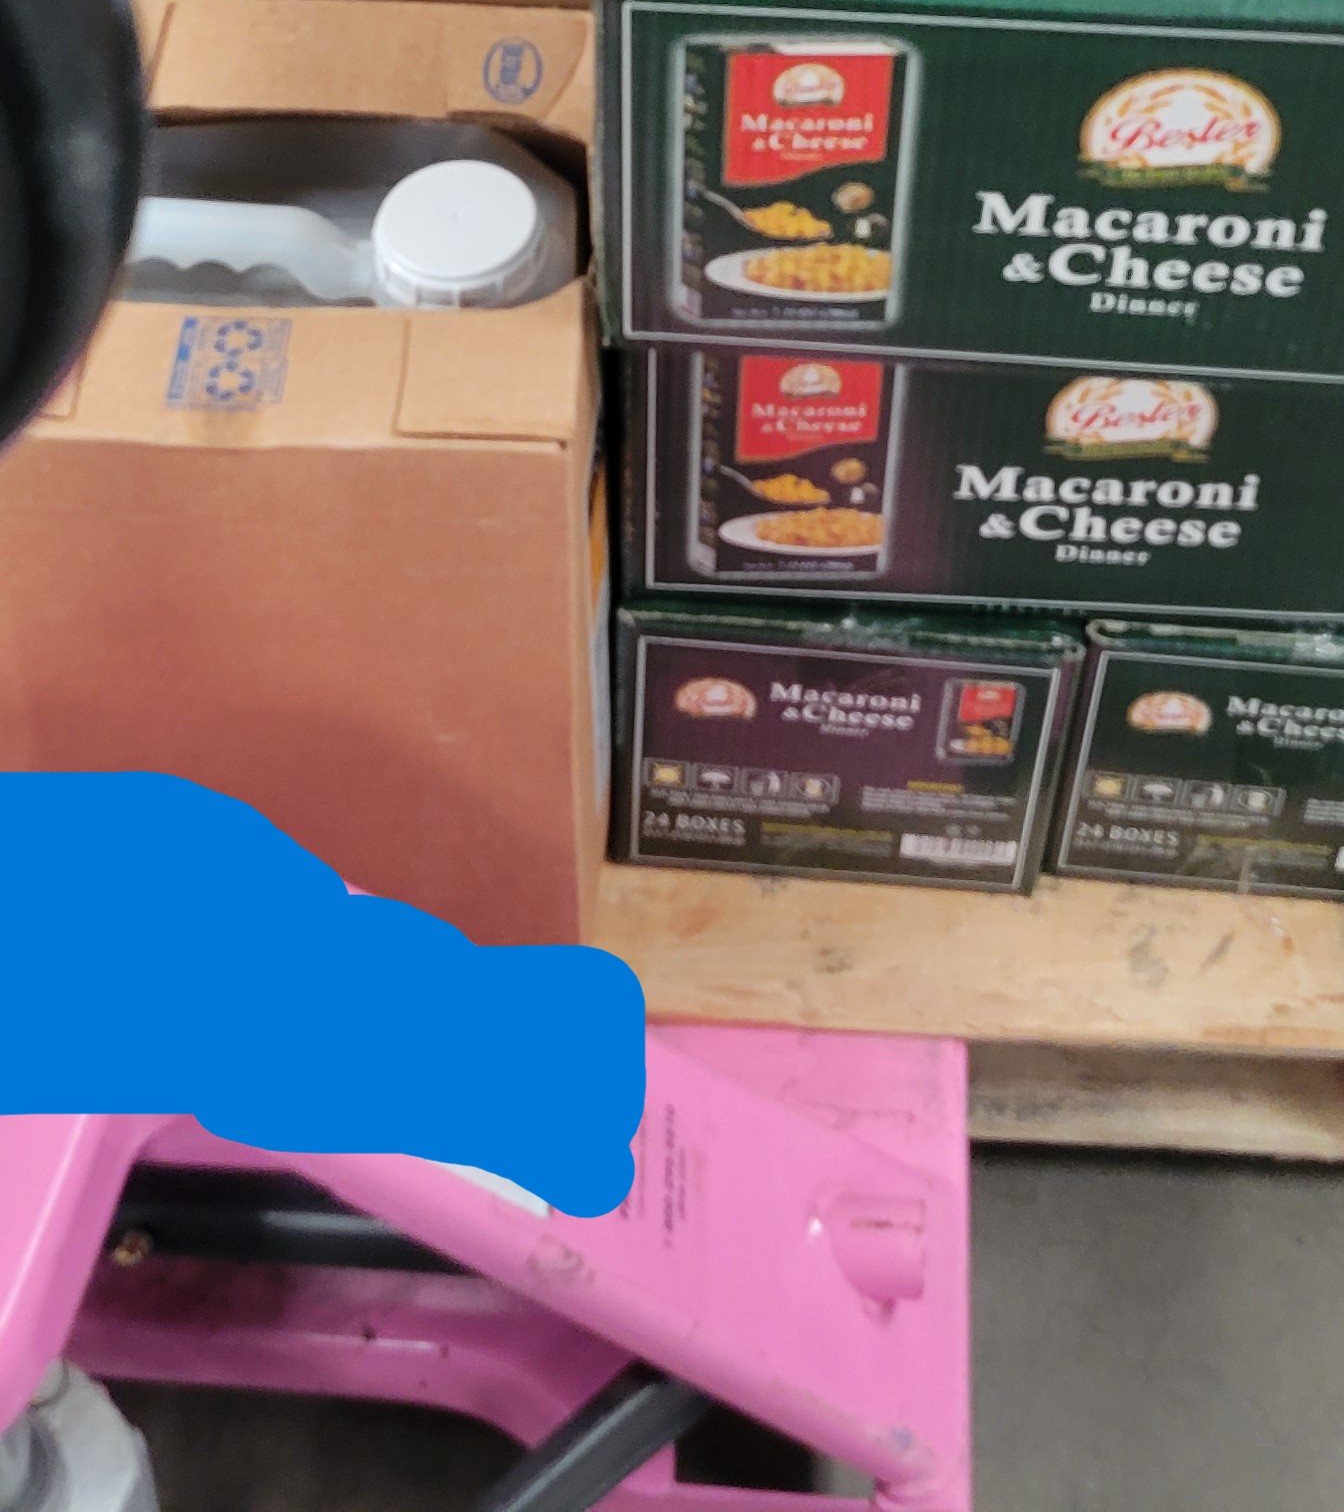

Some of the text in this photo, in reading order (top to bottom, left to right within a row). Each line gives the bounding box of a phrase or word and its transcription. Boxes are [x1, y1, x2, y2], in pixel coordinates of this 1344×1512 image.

[972, 190, 1328, 253] Macaroni
[1089, 291, 1200, 318] Dinner
[953, 464, 1261, 511] Macaroni
[1055, 544, 1153, 567] Dinner
[769, 682, 923, 714] Macaroni
[675, 813, 747, 835] BOXES
[1108, 823, 1181, 847] BOXES
